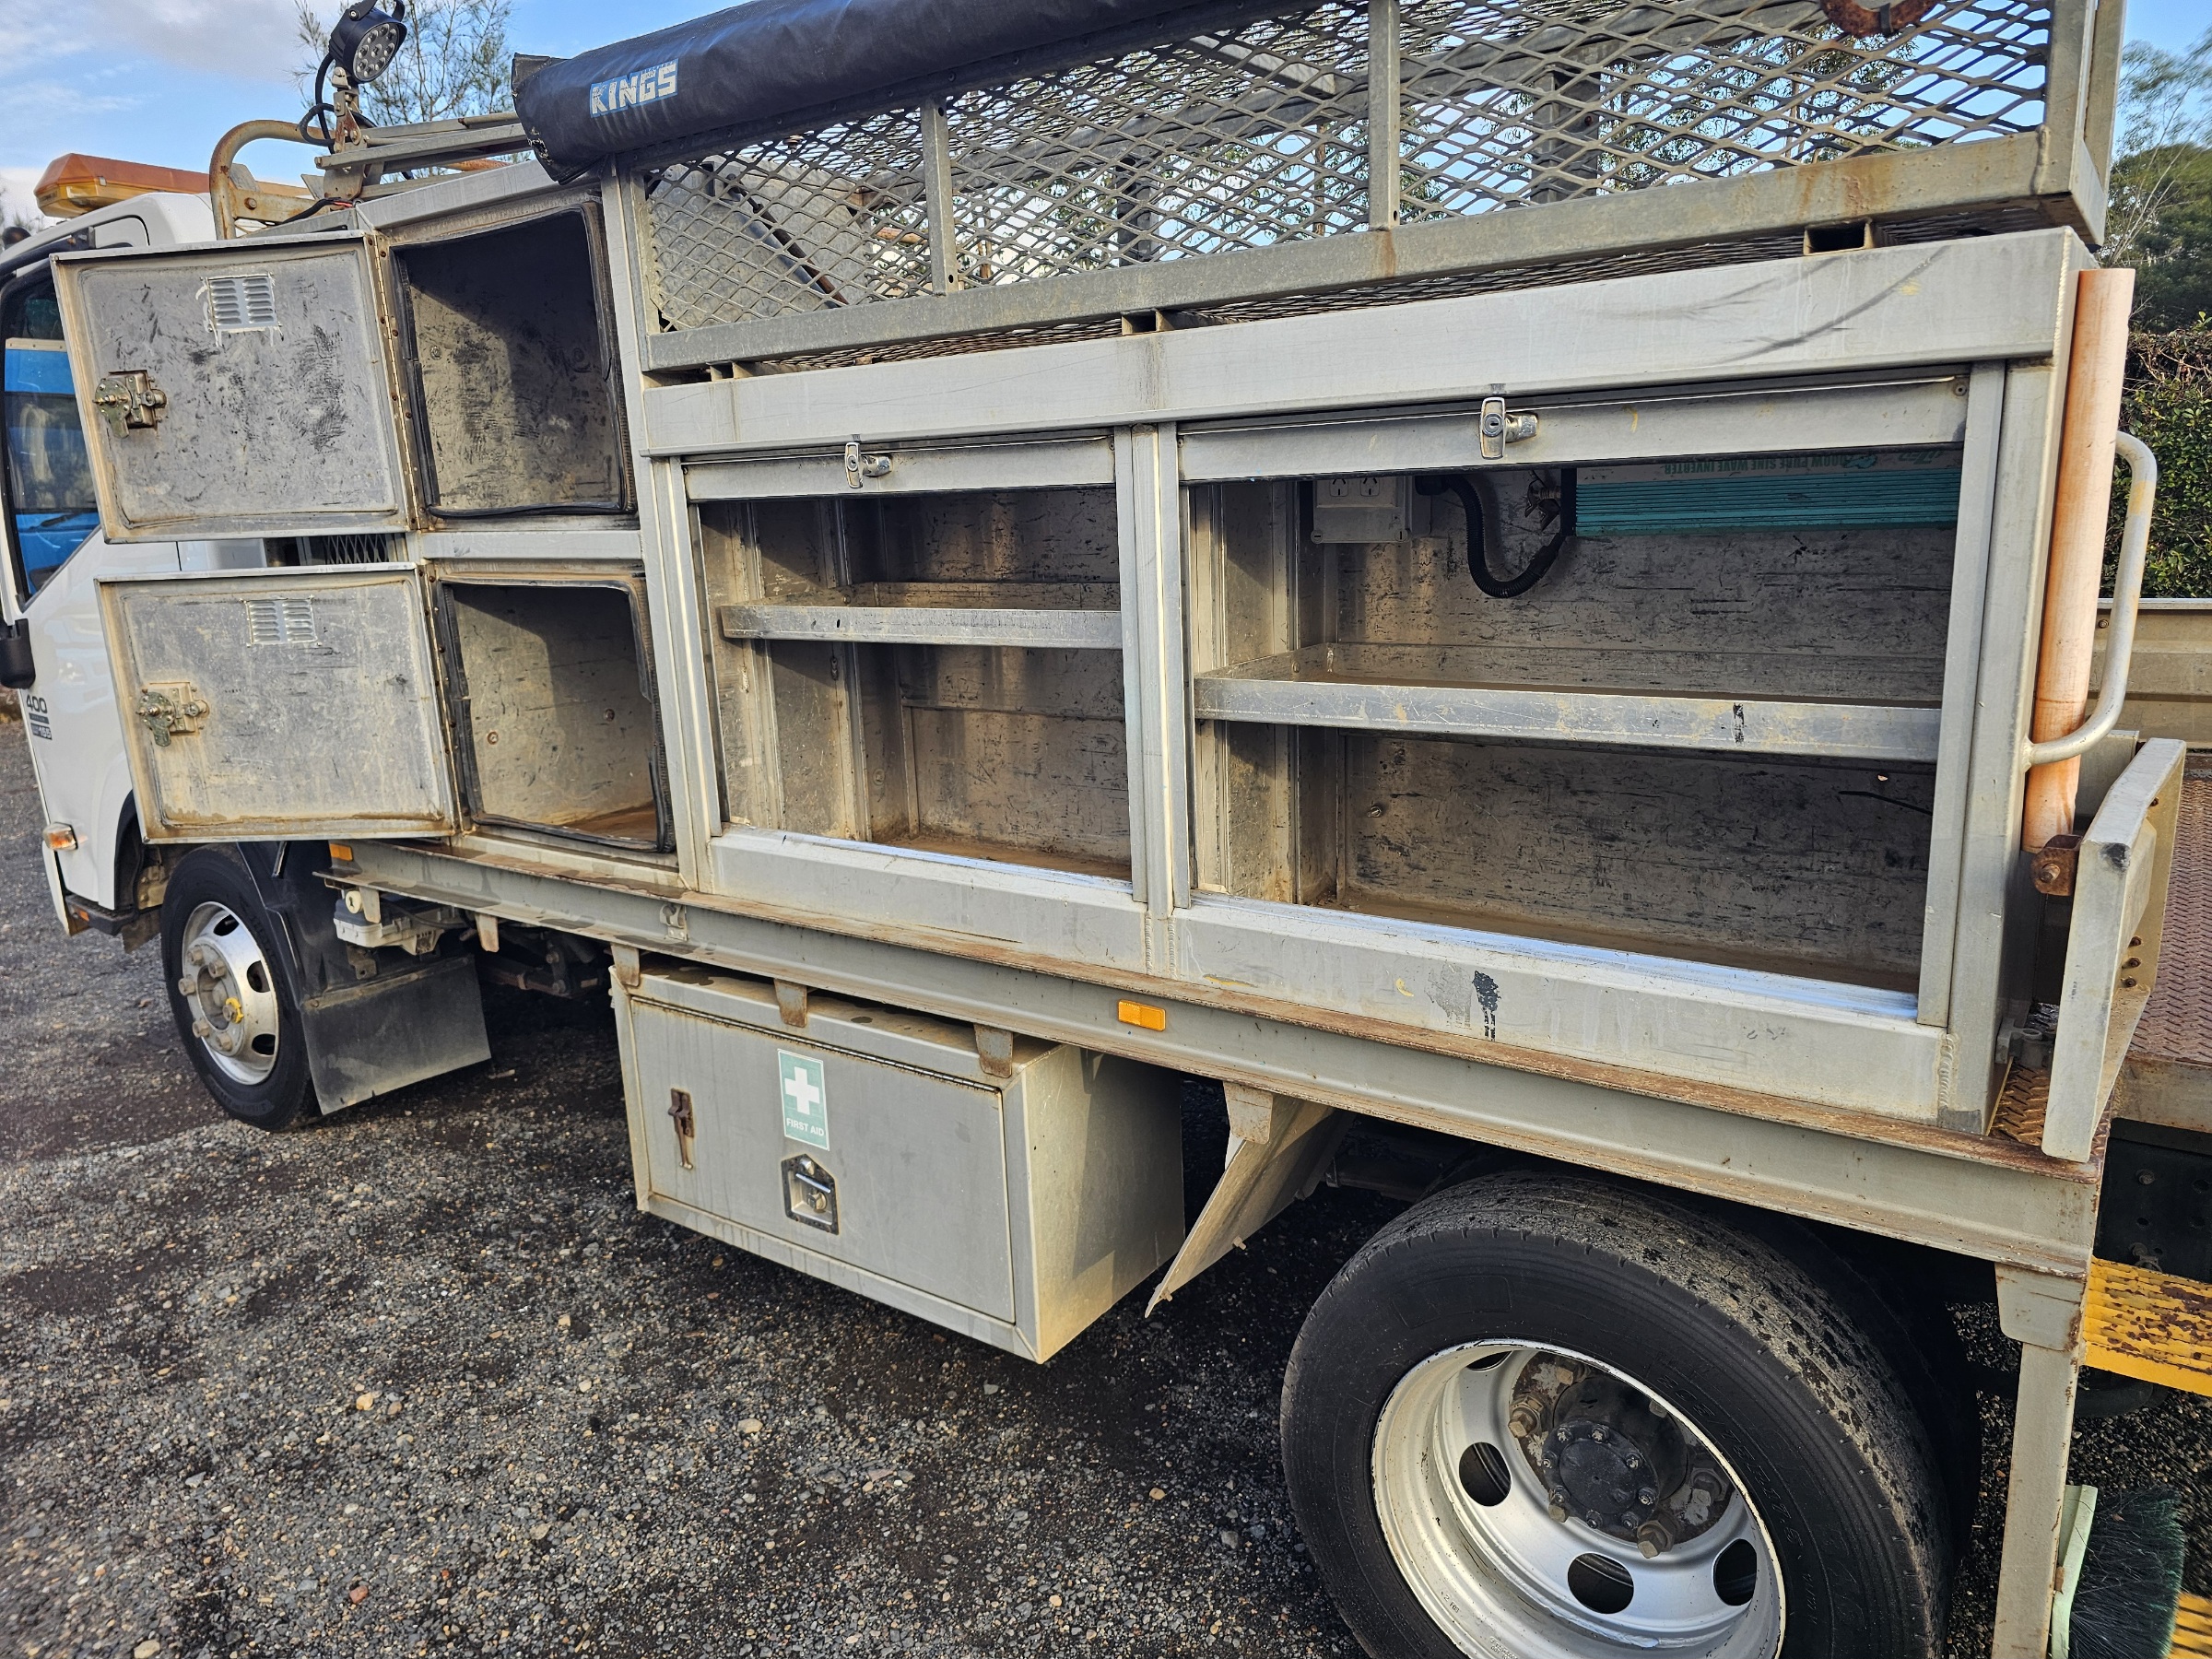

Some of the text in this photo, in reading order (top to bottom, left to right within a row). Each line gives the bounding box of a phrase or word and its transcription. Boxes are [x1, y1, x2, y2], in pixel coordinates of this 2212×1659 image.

[592, 62, 677, 114] KINGS
[1665, 461, 1714, 475] INVERTER
[1717, 460, 1748, 472] WAVE
[1751, 459, 1777, 470] SINE
[26, 694, 48, 714] 400
[785, 1118, 825, 1136] FIRST AID
